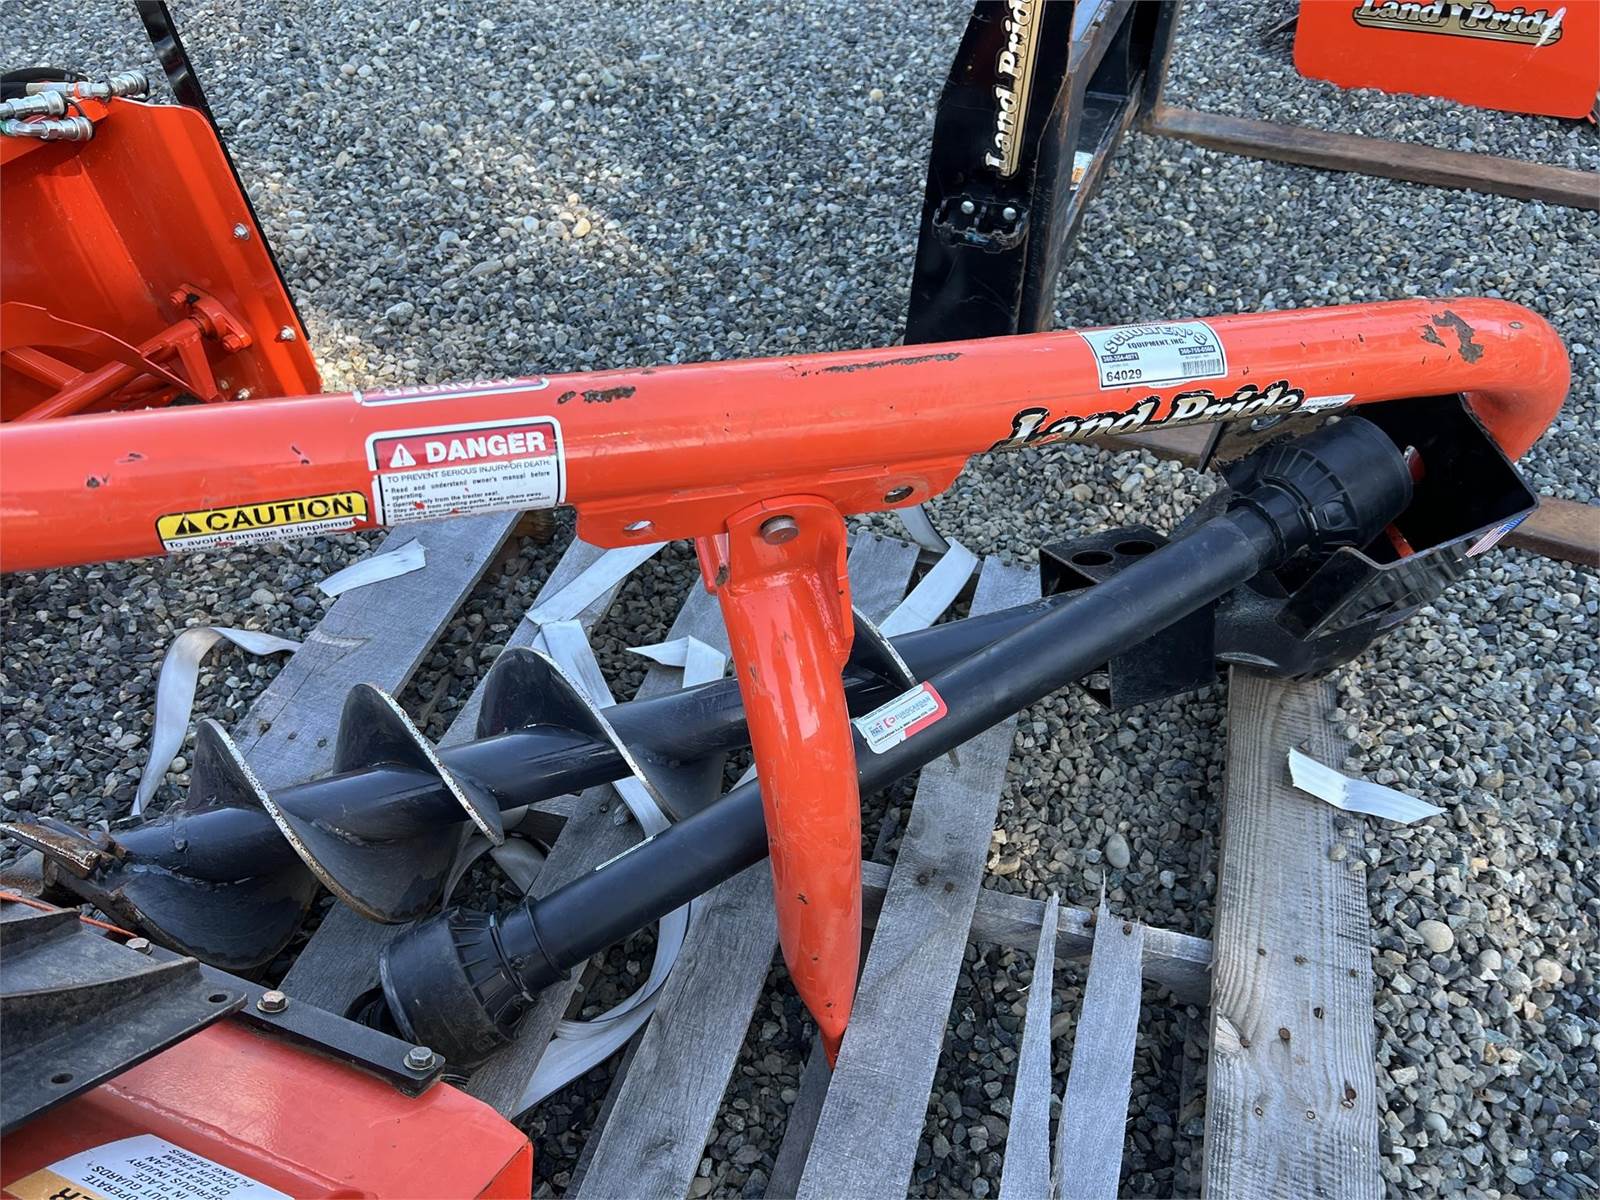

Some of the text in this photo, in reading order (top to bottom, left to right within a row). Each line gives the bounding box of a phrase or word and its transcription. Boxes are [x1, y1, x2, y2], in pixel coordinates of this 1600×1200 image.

[1357, 0, 1446, 24] Land
[986, 0, 1032, 176] Land Prid
[1106, 368, 1142, 382] 64029
[1002, 382, 1301, 447] Land Pride
[425, 431, 546, 464] DANGER
[401, 471, 439, 481] PREVENT
[441, 467, 478, 478] SERIOUS
[479, 464, 508, 473] INJURY
[431, 480, 467, 489] understand
[472, 476, 497, 485] owner's
[502, 473, 526, 481] manual
[206, 496, 354, 531] CAUTION
[167, 541, 183, 549] To
[187, 536, 222, 546] avoid
[226, 530, 278, 542] damage
[297, 519, 357, 533] implemen
[91, 1165, 143, 1190] GUARDS
[125, 1158, 171, 1179] INJURY
[145, 1156, 230, 1196] OR DEATH CAN
[162, 1154, 238, 1189] OCCUR FROM
[211, 1167, 254, 1188] FLYING
[171, 1190, 189, 1199] IN
